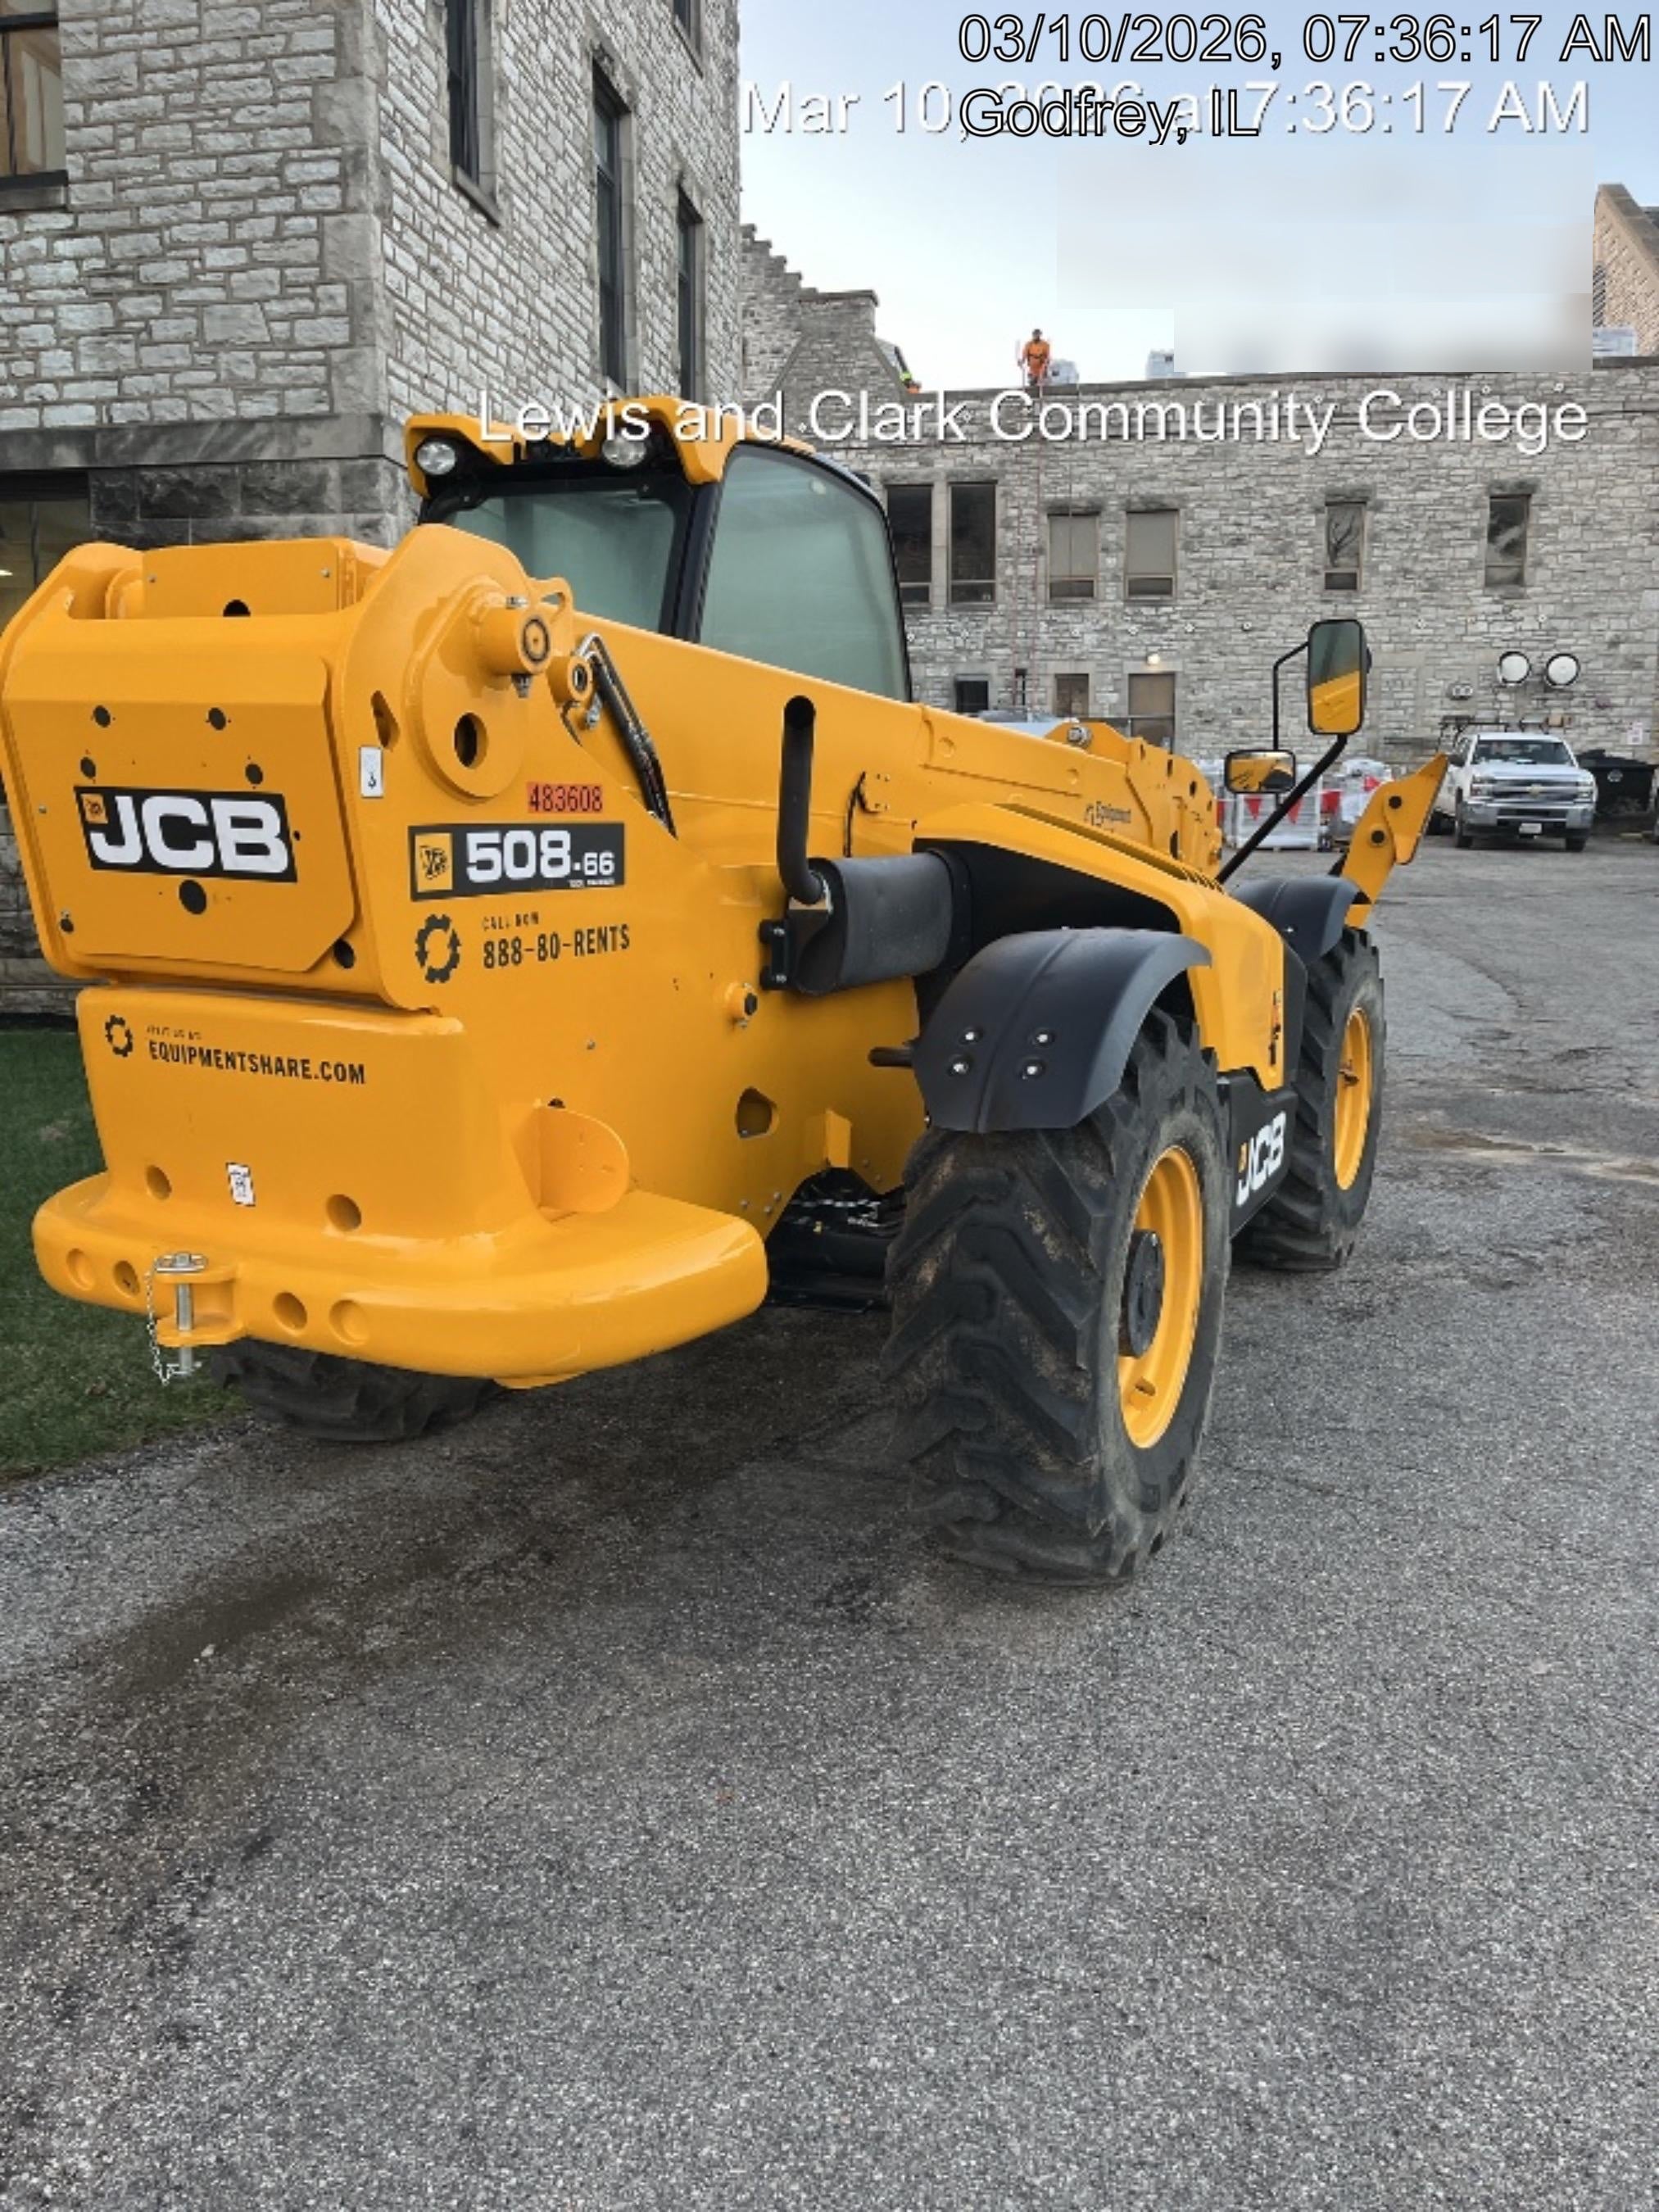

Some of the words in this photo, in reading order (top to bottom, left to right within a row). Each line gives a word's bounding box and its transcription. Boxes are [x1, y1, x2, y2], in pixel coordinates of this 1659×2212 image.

[528, 783, 604, 812] 483608
[89, 795, 288, 874] JCB
[483, 922, 631, 970] 888-80-RENTS
[148, 1038, 366, 1085] EQUIPMENTSHARE.COM
[1235, 1110, 1287, 1208] JCB
